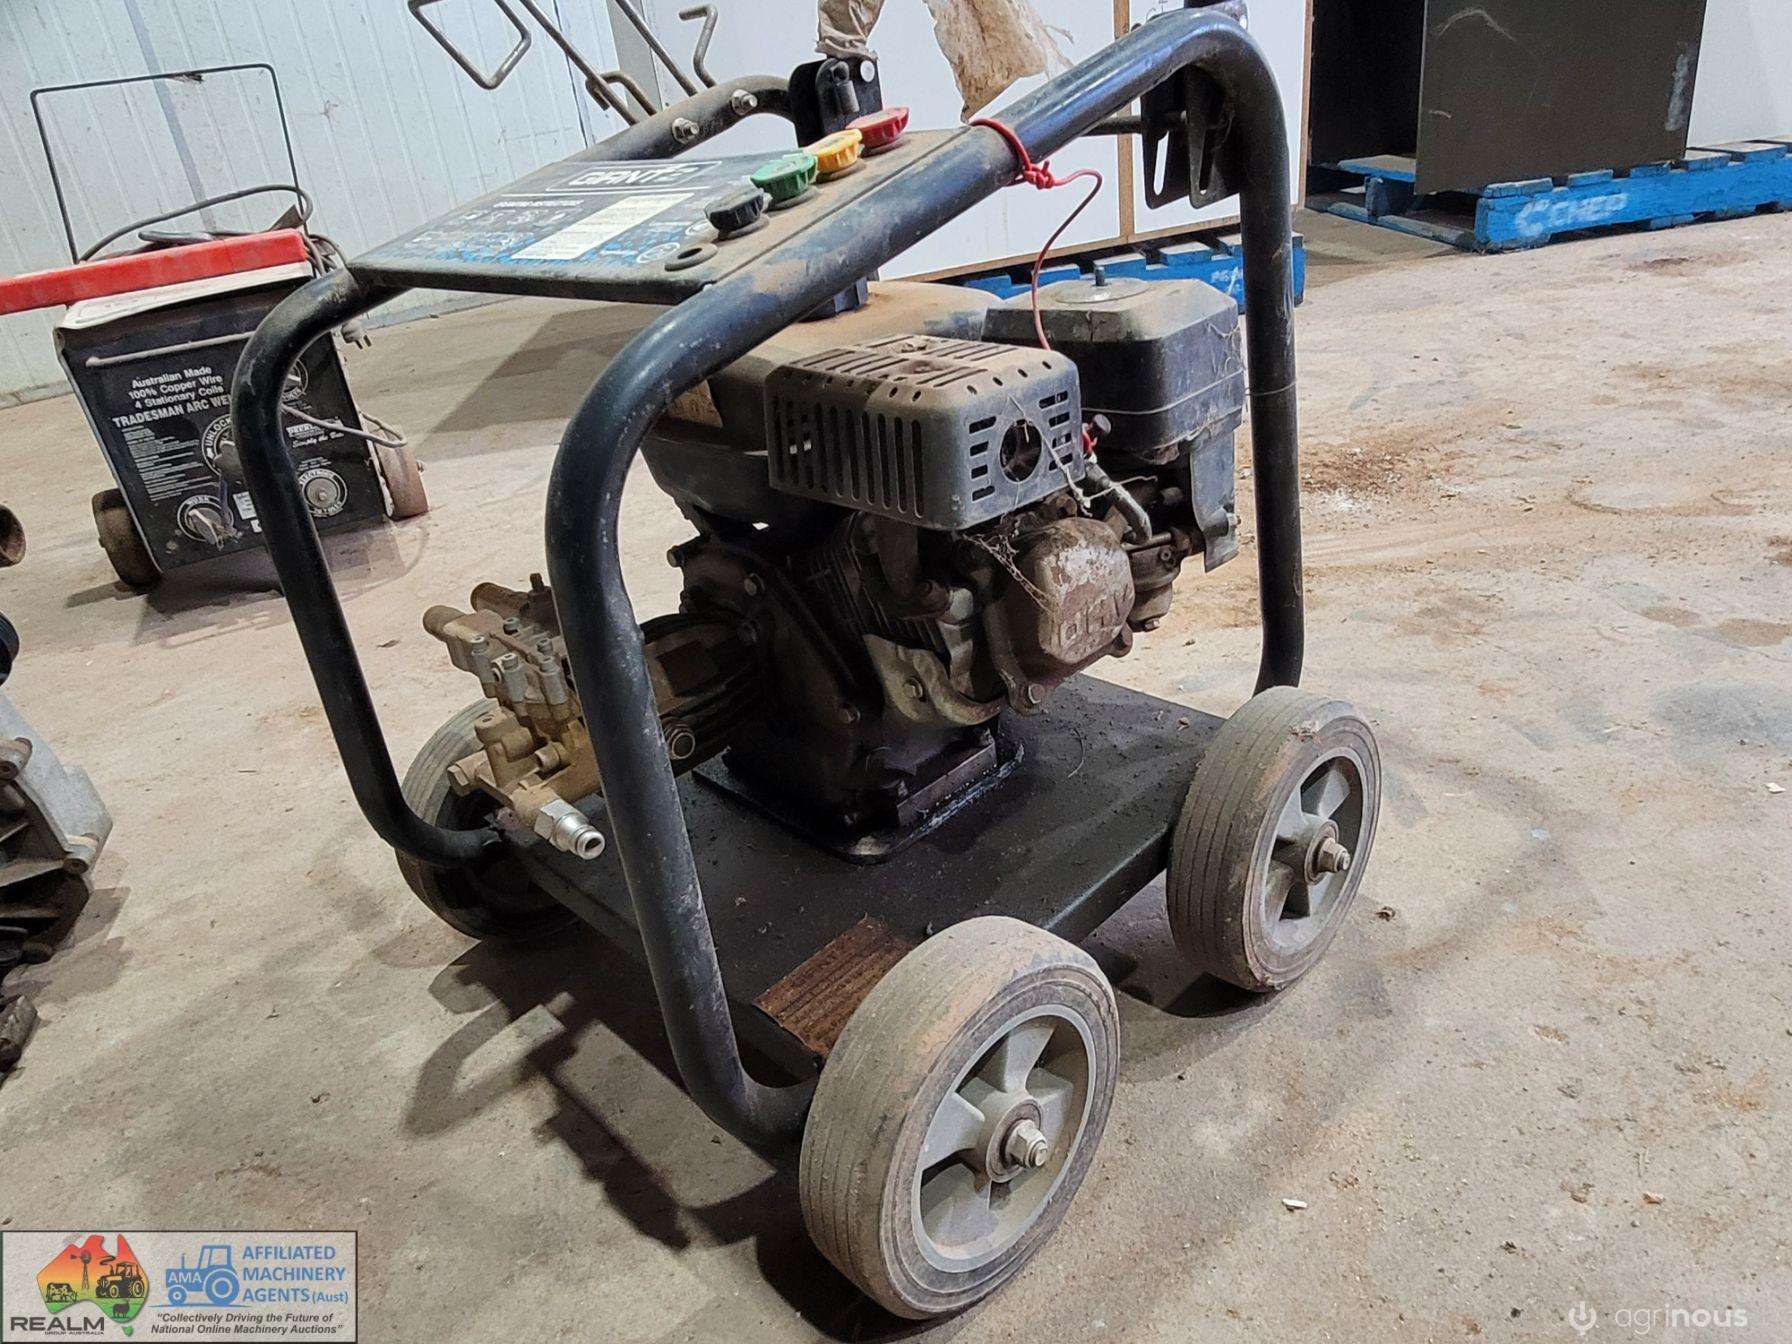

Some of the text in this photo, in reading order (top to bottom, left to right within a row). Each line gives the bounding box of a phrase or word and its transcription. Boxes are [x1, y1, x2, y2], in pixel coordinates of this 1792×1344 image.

[128, 374, 223, 400] 100% Copper Wire
[132, 366, 212, 389] Australian Made
[134, 385, 224, 409] 4 Stationary Coils
[112, 404, 185, 428] TRADESMAN
[186, 399, 210, 414] ARC
